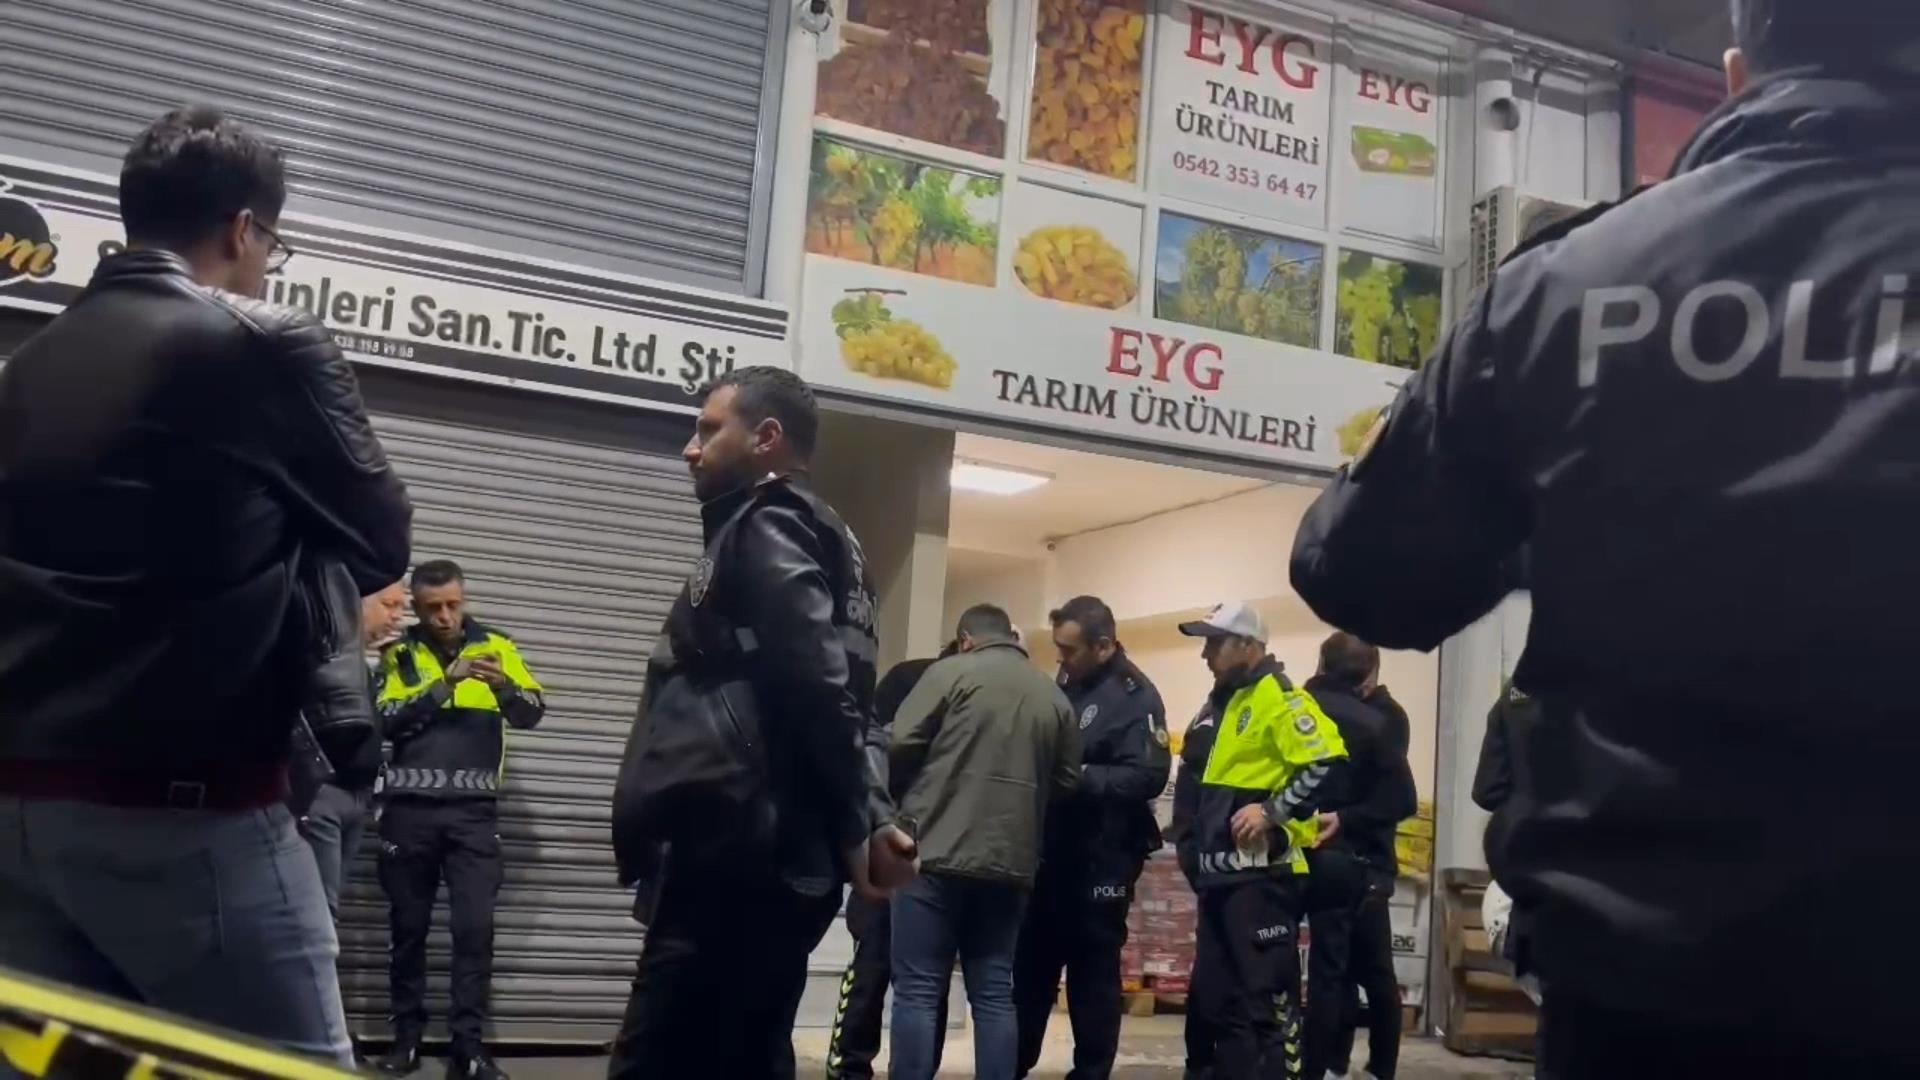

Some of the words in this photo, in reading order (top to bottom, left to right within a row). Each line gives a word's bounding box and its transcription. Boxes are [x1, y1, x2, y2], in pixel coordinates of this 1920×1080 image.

[1185, 5, 1319, 90] EYG
[1205, 79, 1295, 125] TARIM
[1357, 67, 1431, 113] EYG
[1175, 103, 1320, 166] ÜRÜNLERİ
[1173, 151, 1220, 178] 0542
[1227, 163, 1260, 189] 353
[1266, 173, 1289, 195] 64
[1294, 181, 1318, 201] 47
[591, 325, 667, 377] Ltd.
[1105, 325, 1225, 391] EYG
[992, 369, 1119, 420] TARIM
[1130, 386, 1317, 453] ÜRÜNLERİ
